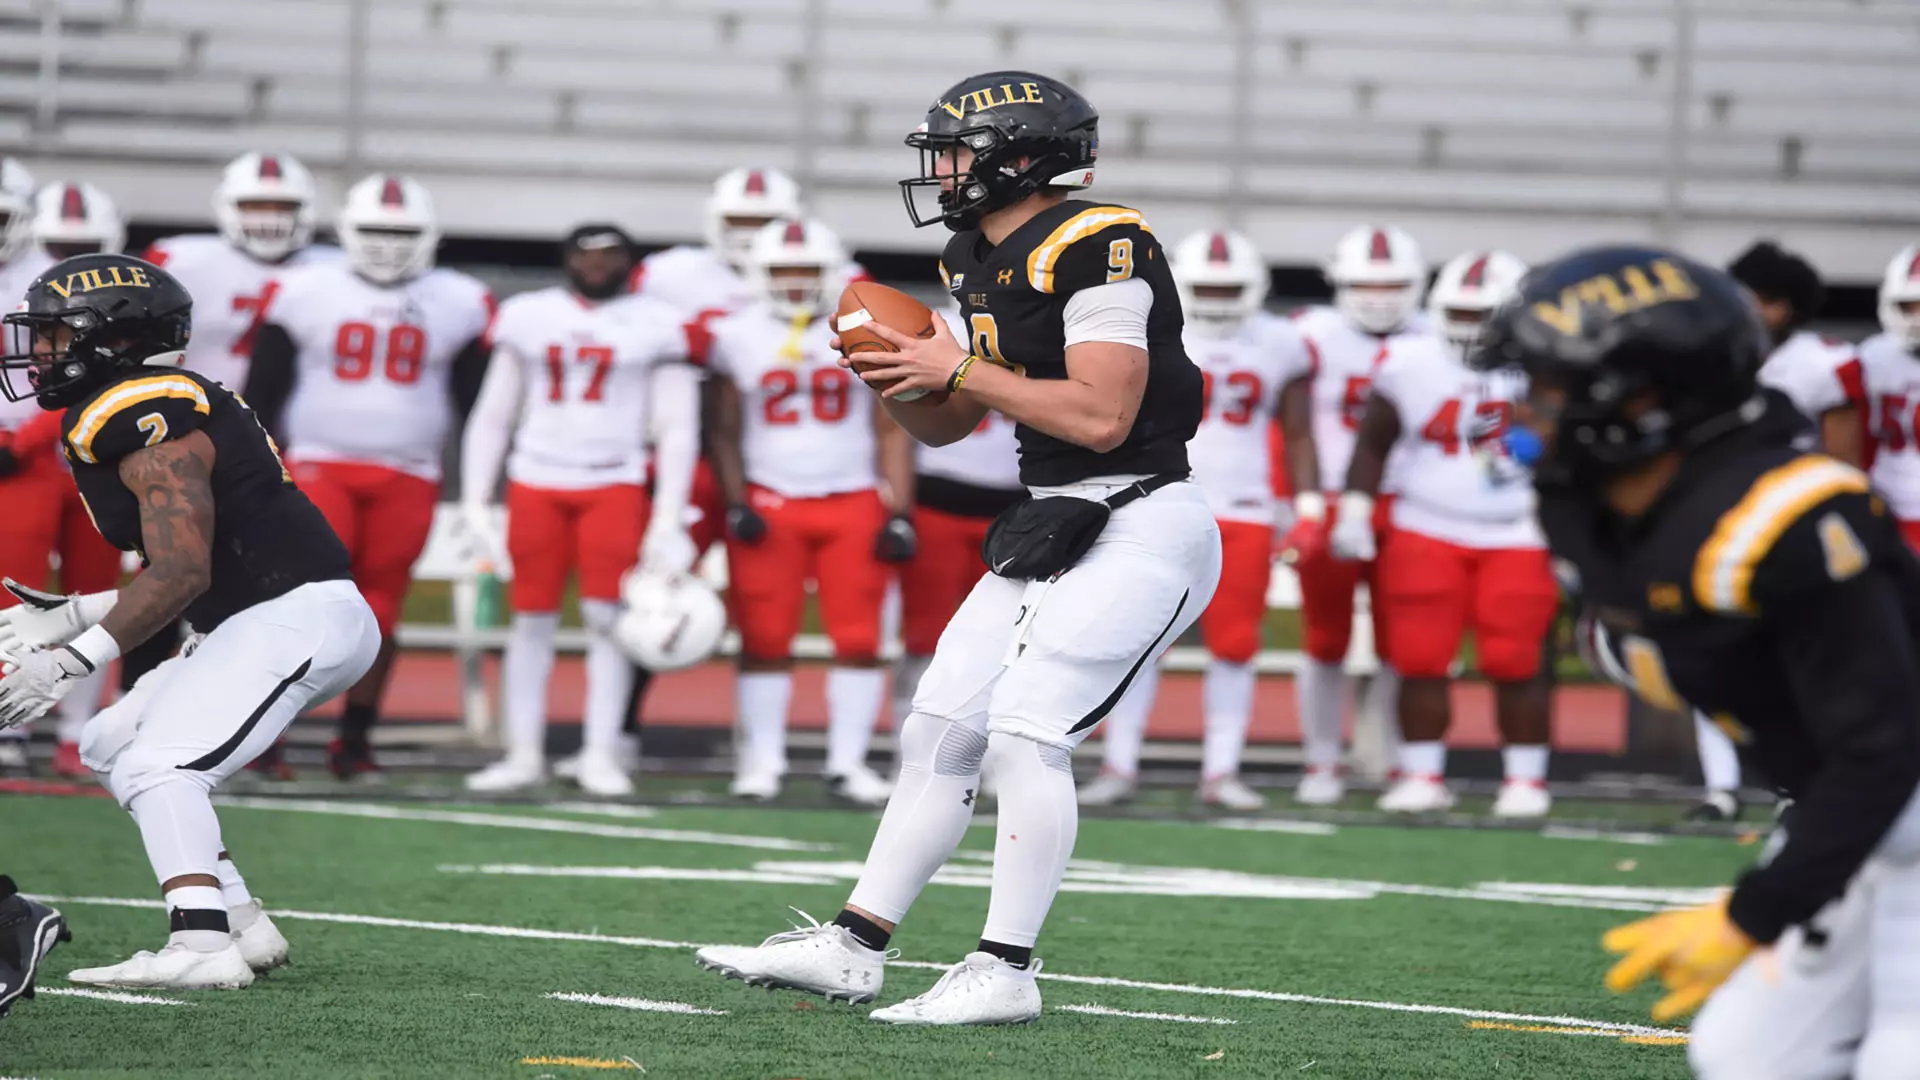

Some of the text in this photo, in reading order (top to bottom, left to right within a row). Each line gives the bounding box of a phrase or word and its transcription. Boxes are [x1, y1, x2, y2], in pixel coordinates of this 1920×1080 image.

[943, 82, 1043, 119] VILLE
[48, 266, 150, 299] VILLE
[1107, 238, 1134, 283] 9
[968, 293, 988, 308] VILLE
[1534, 258, 1700, 336] VILLE
[334, 322, 424, 384] 98
[546, 346, 613, 403] 17
[761, 368, 850, 424] 28
[137, 412, 168, 447] 2
